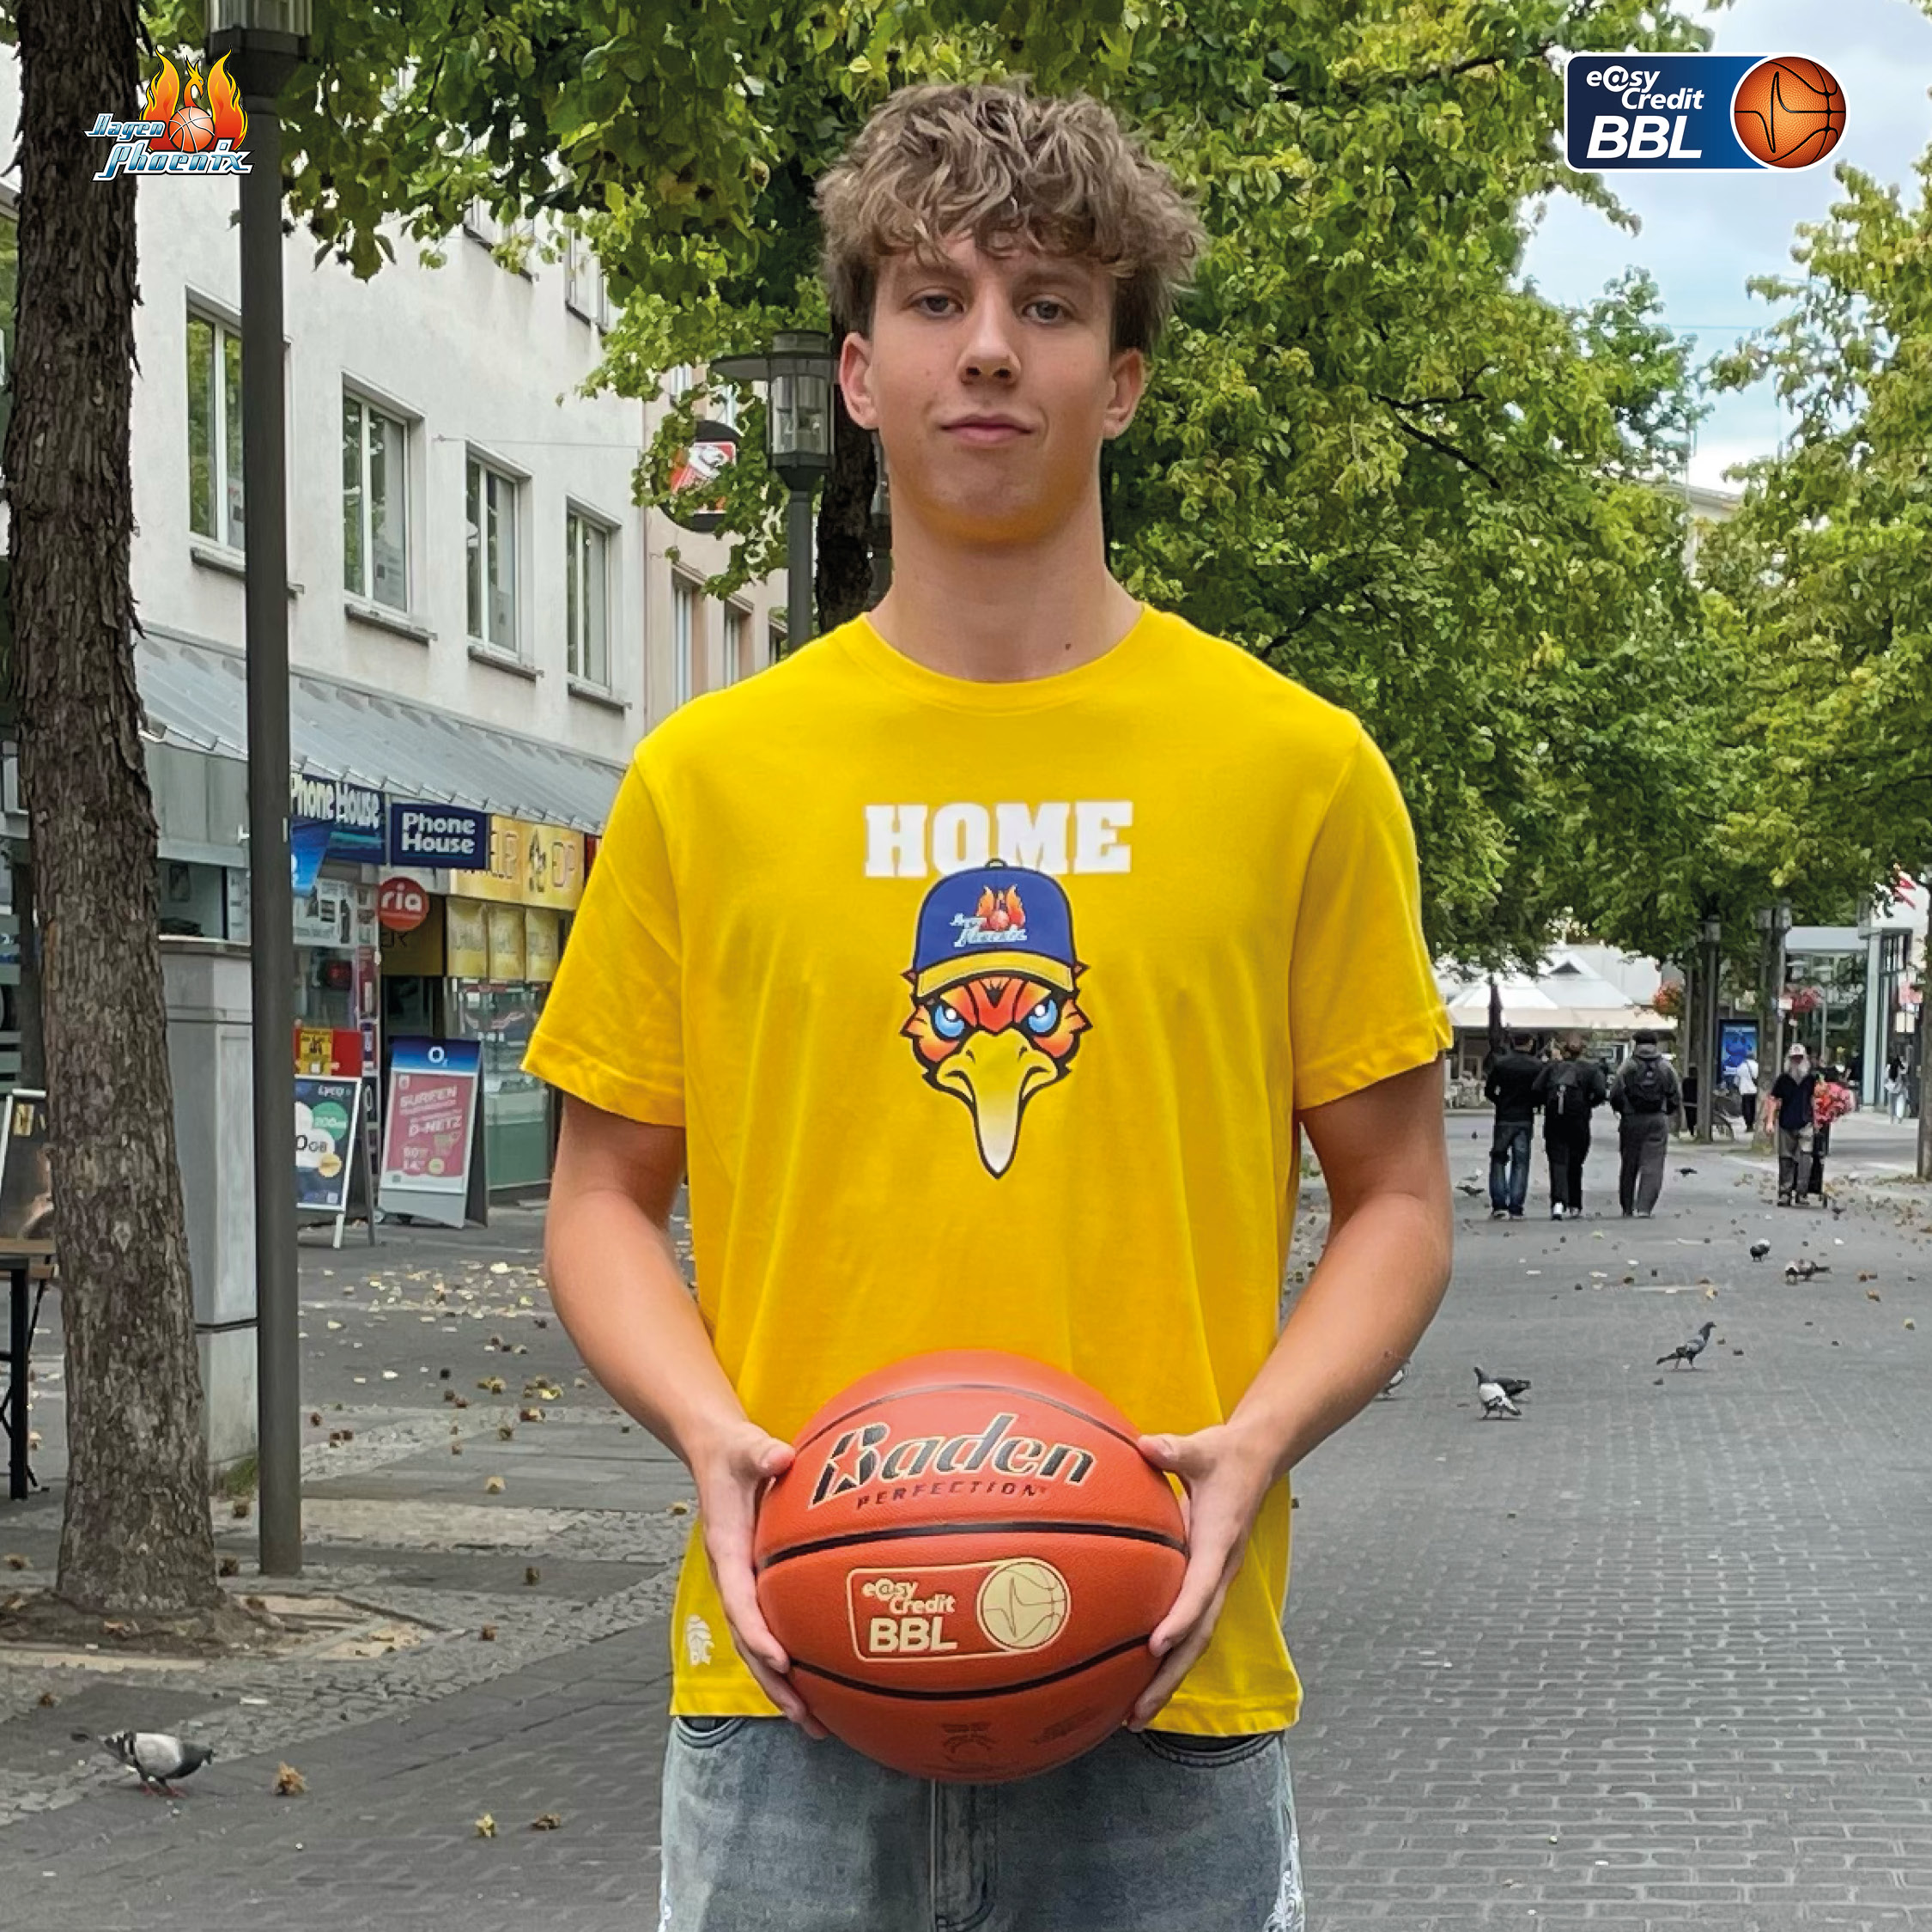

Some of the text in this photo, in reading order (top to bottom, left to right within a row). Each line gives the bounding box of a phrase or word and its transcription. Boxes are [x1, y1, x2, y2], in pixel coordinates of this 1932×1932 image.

[336, 781, 380, 829] House
[401, 811, 476, 835] Phone
[401, 831, 476, 854] House
[865, 800, 1133, 878] HOME
[380, 882, 422, 911] ria
[807, 1412, 1097, 1510] Baden
[857, 1480, 1037, 1510] PERFECTION
[862, 1577, 918, 1601] e@sy
[890, 1594, 956, 1614] Credit
[869, 1616, 958, 1653] BBL
